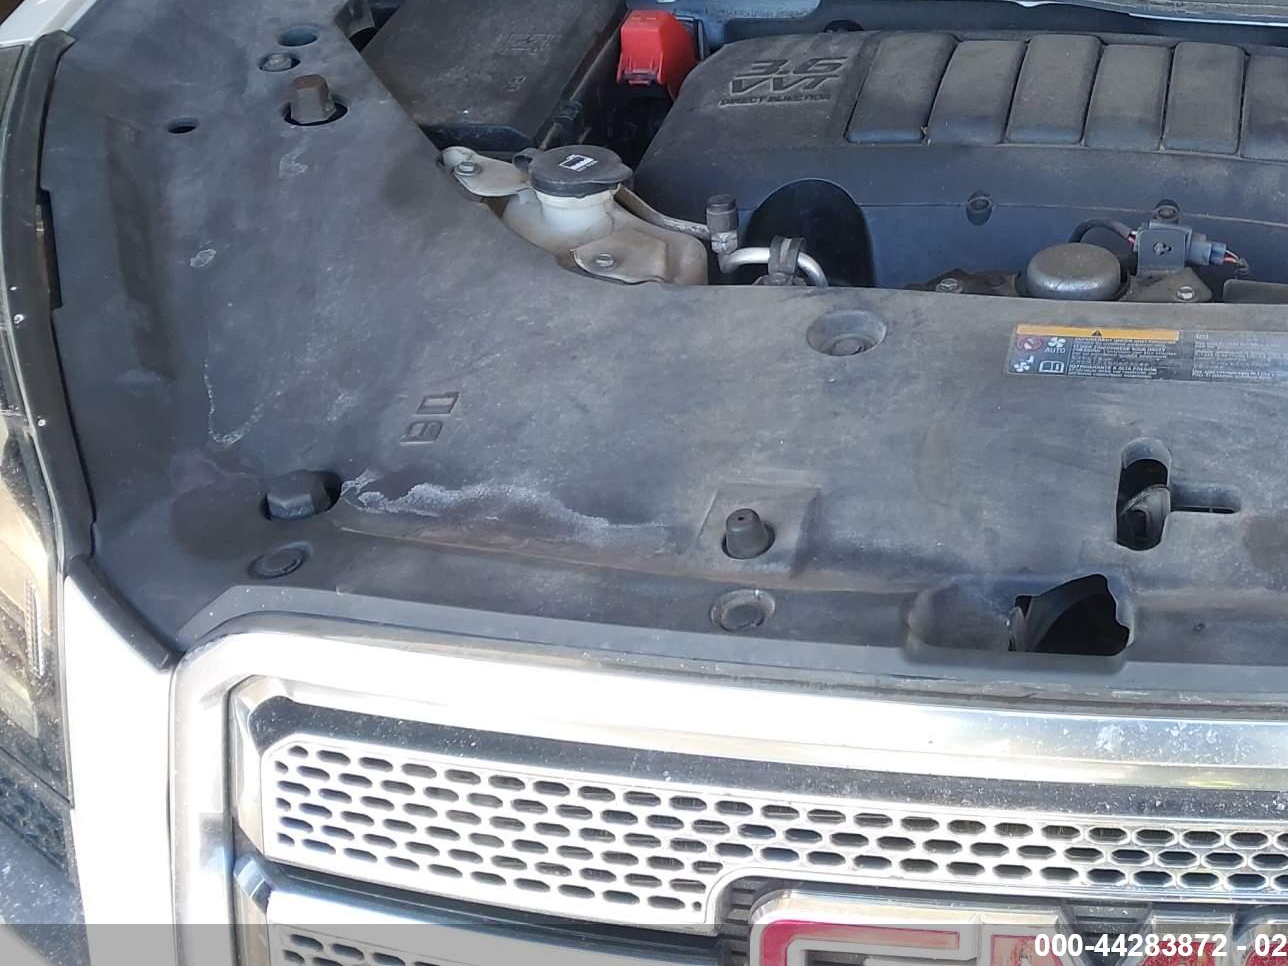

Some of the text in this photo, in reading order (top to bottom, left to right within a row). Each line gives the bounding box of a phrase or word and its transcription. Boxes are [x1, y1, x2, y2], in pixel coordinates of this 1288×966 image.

[734, 56, 848, 77] 3.6
[729, 75, 840, 95] VVT
[719, 97, 766, 107] DIRECT
[1044, 346, 1066, 354] AUTO
